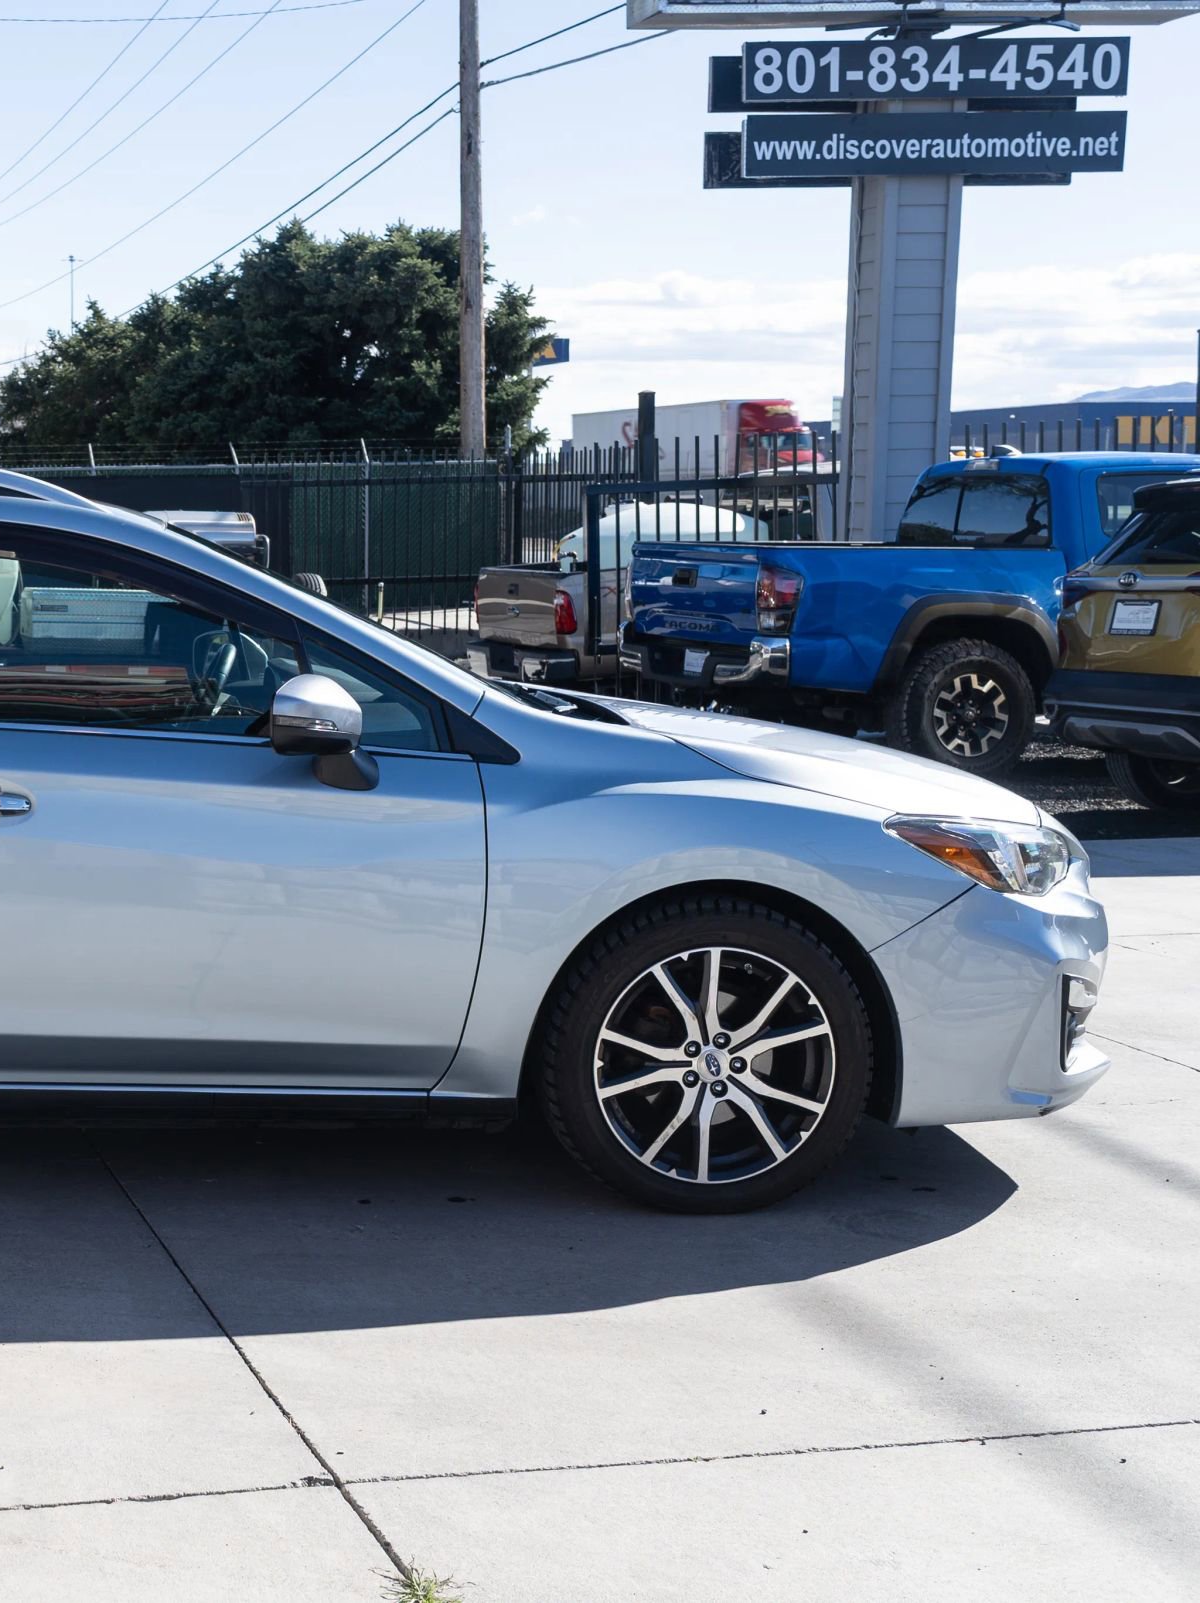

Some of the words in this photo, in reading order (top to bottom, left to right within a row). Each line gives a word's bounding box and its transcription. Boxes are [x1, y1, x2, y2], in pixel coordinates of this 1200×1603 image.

[753, 43, 1121, 94] 801-834-4540
[753, 130, 1119, 161] www.discoverautomotive.net
[1120, 574, 1136, 584] KIA
